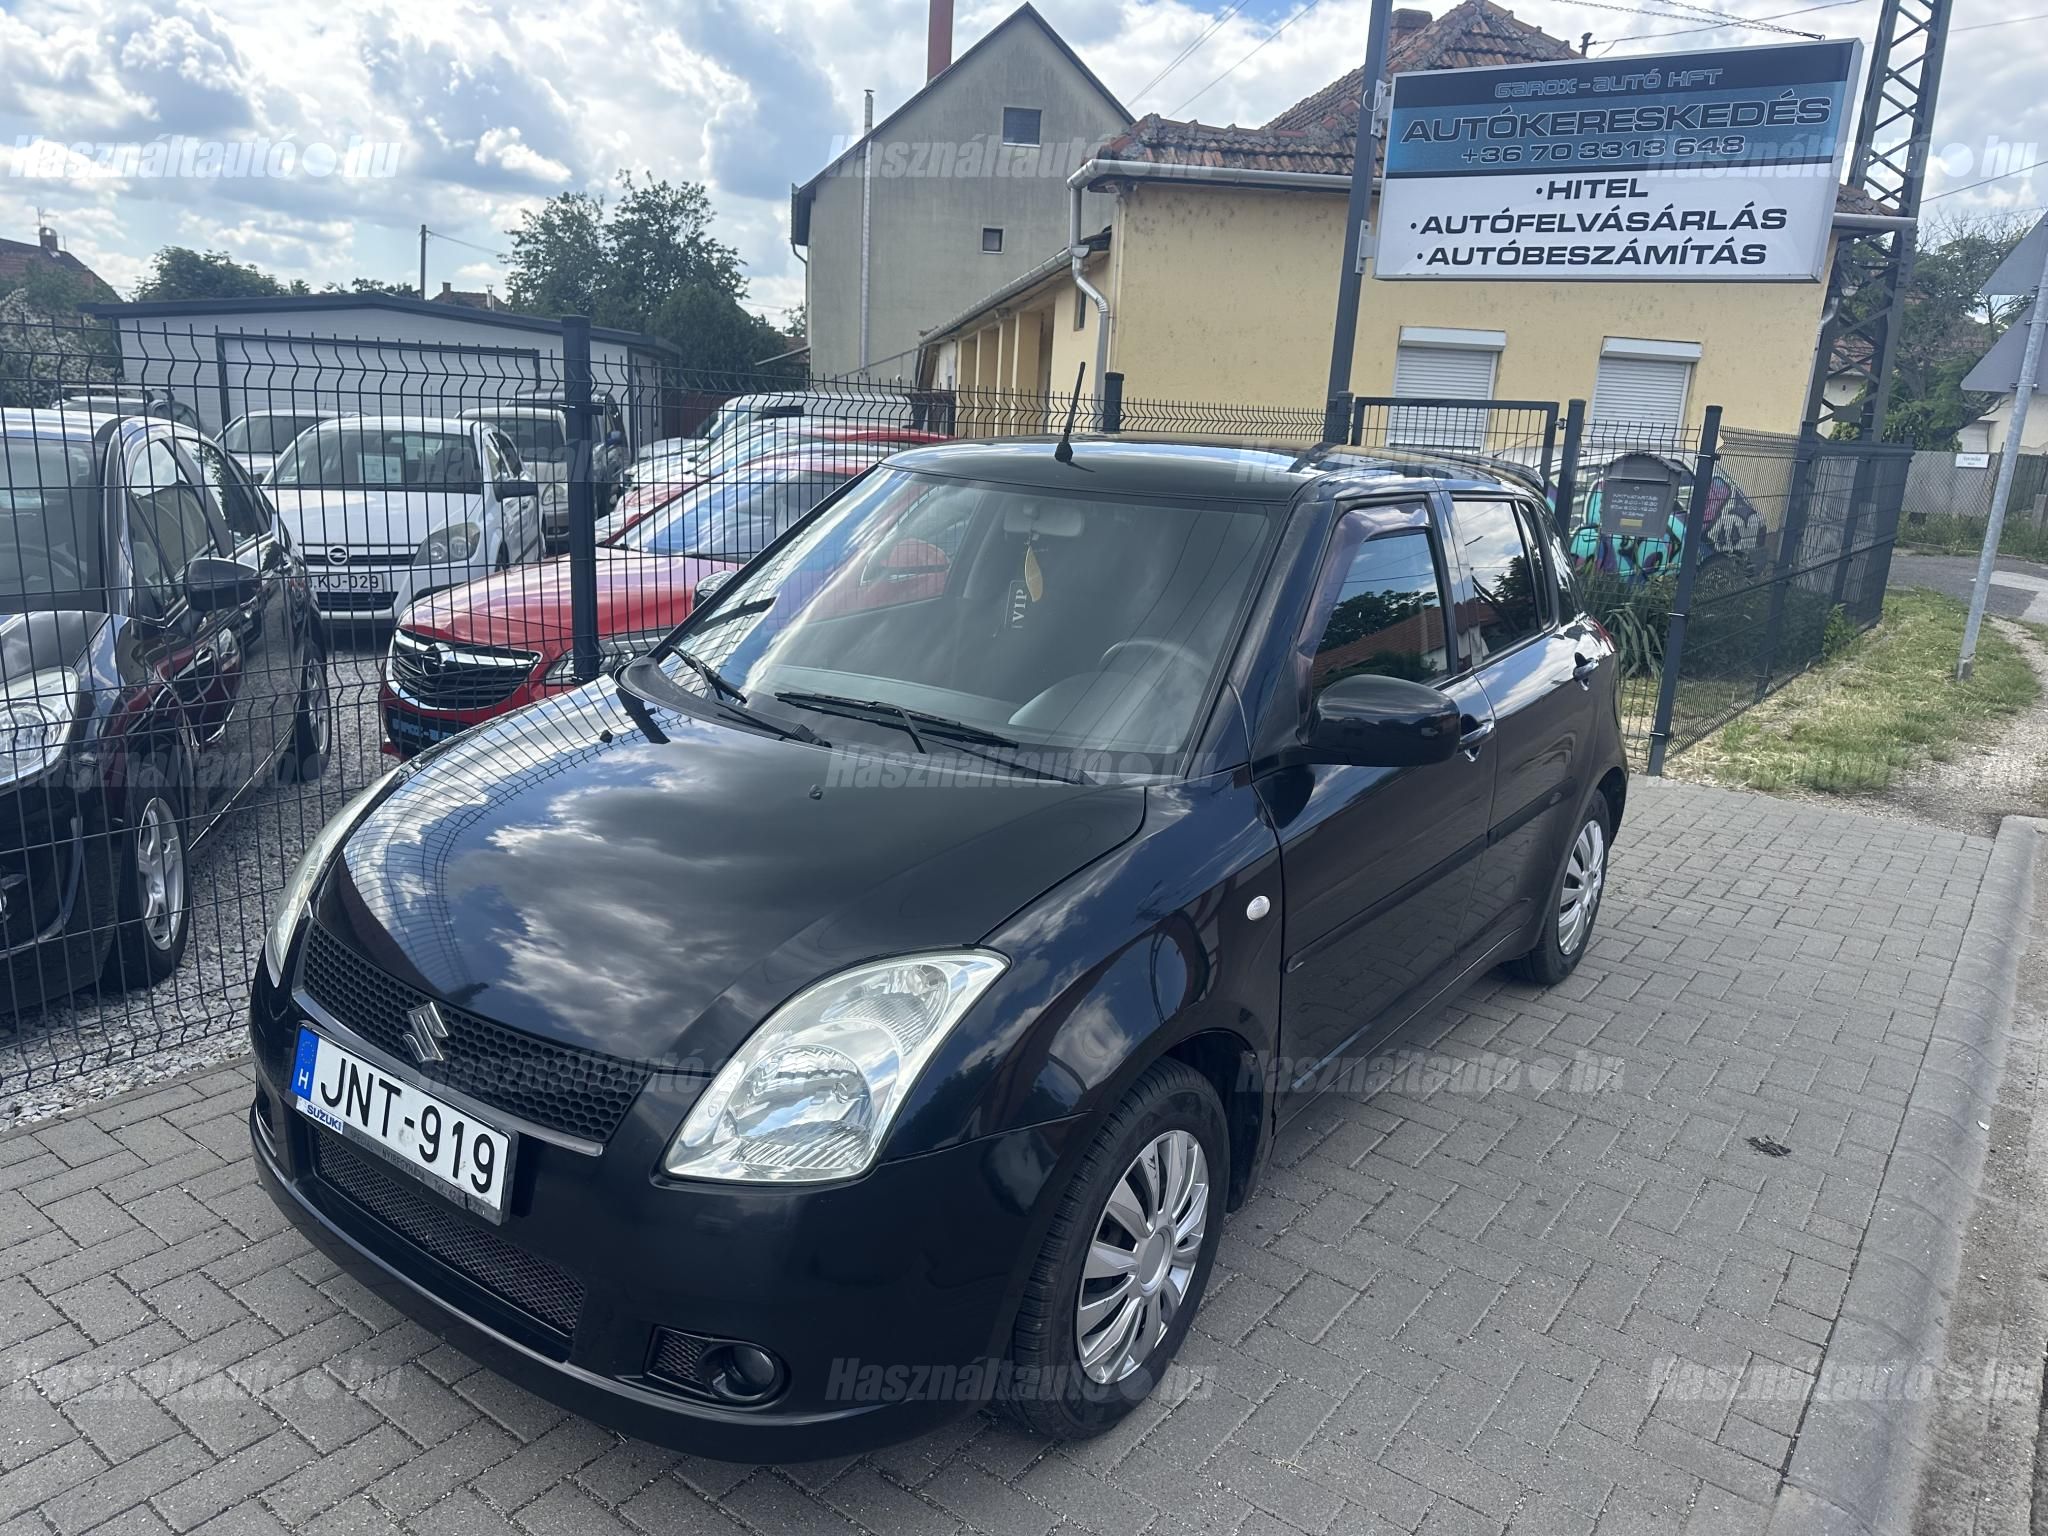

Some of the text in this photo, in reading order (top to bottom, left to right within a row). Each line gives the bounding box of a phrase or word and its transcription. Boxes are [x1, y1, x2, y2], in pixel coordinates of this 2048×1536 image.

[1401, 89, 1832, 143] AUTÓKERESKEDÉS
[1461, 134, 1746, 164] +36 70 3313 648
[1546, 177, 1649, 200] HITEL
[1420, 202, 1788, 235] AUTÓFELVÁSÁRLÁS
[1426, 237, 1767, 265] AUTÓBESZÁMÍTÁS
[298, 1068, 309, 1089] H
[307, 1104, 343, 1131] SUZUKI
[320, 1058, 495, 1194] JNT-919
